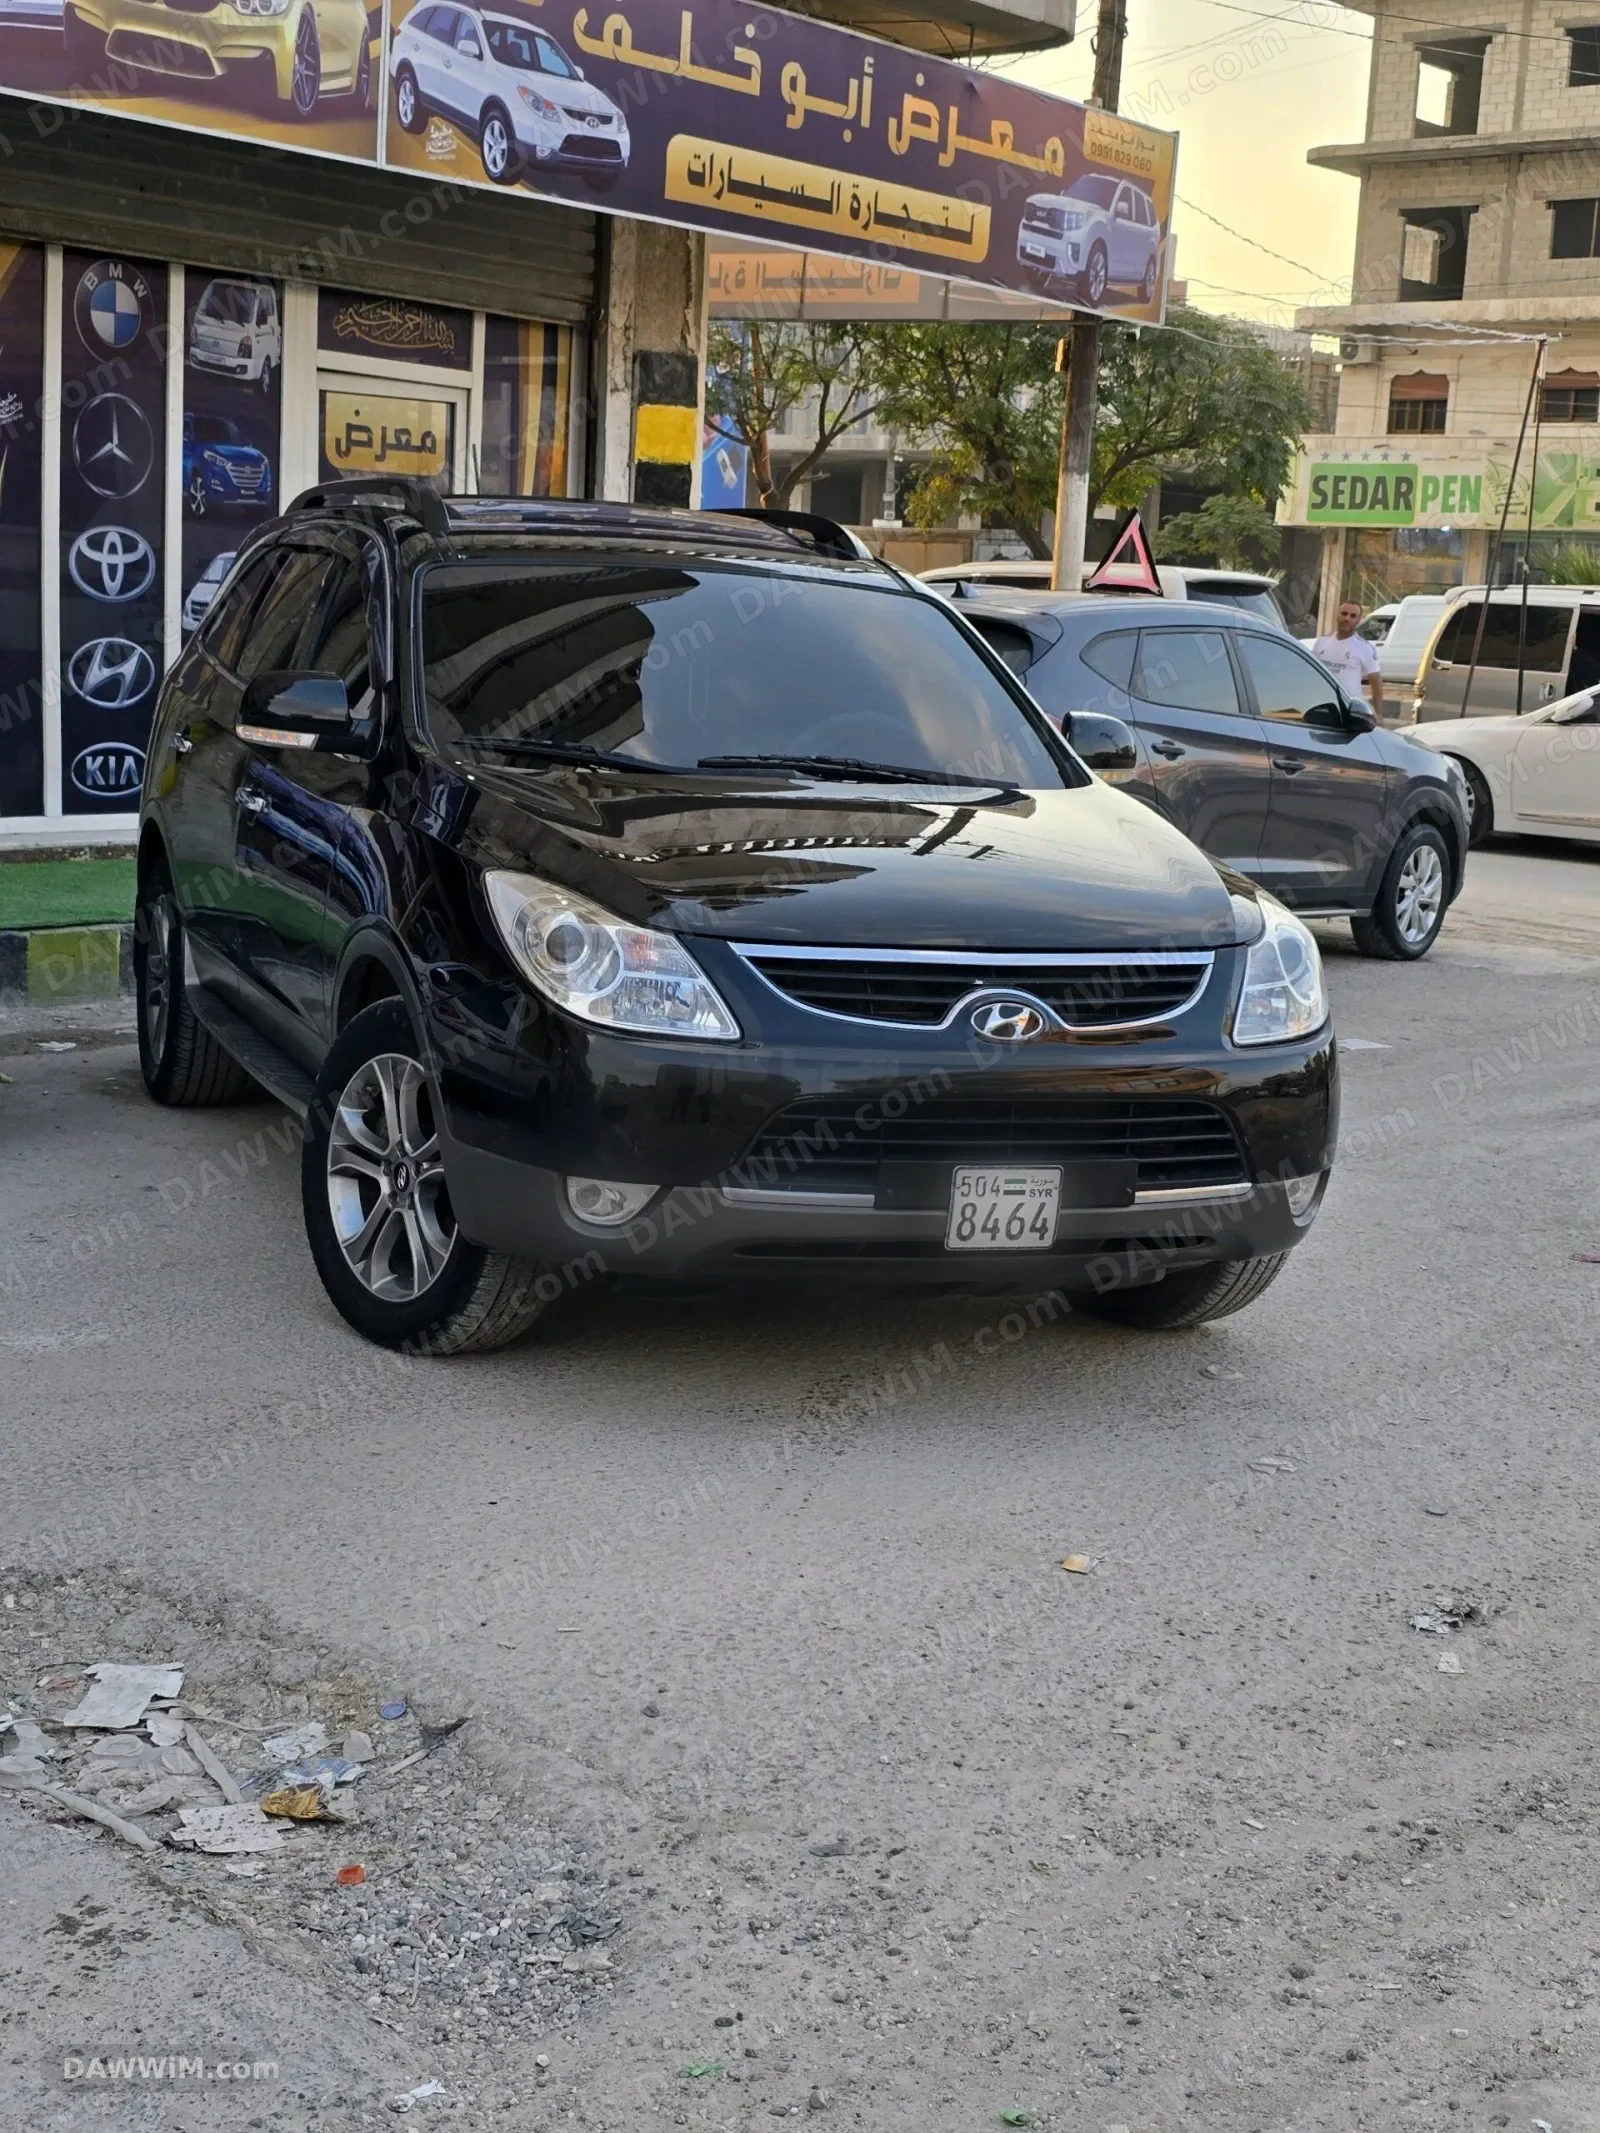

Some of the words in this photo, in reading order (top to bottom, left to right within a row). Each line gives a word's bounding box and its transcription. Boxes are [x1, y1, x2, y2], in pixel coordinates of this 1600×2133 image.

[779, 56, 875, 143] أبو
[888, 72, 1064, 178] معرض
[1091, 142, 1113, 160] 0991
[1114, 149, 1131, 166] 829
[1132, 155, 1152, 172] 060
[686, 151, 842, 216] السيارات
[850, 180, 976, 246] لتجارة
[83, 261, 148, 298] BMW
[334, 408, 438, 463] معرض
[1310, 474, 1414, 512] SEDAR
[1420, 474, 1483, 514] PEN
[85, 755, 140, 786] KIA
[960, 1175, 1001, 1198] 504
[1028, 1188, 1053, 1198] SYR
[955, 1201, 1049, 1242] 8464
